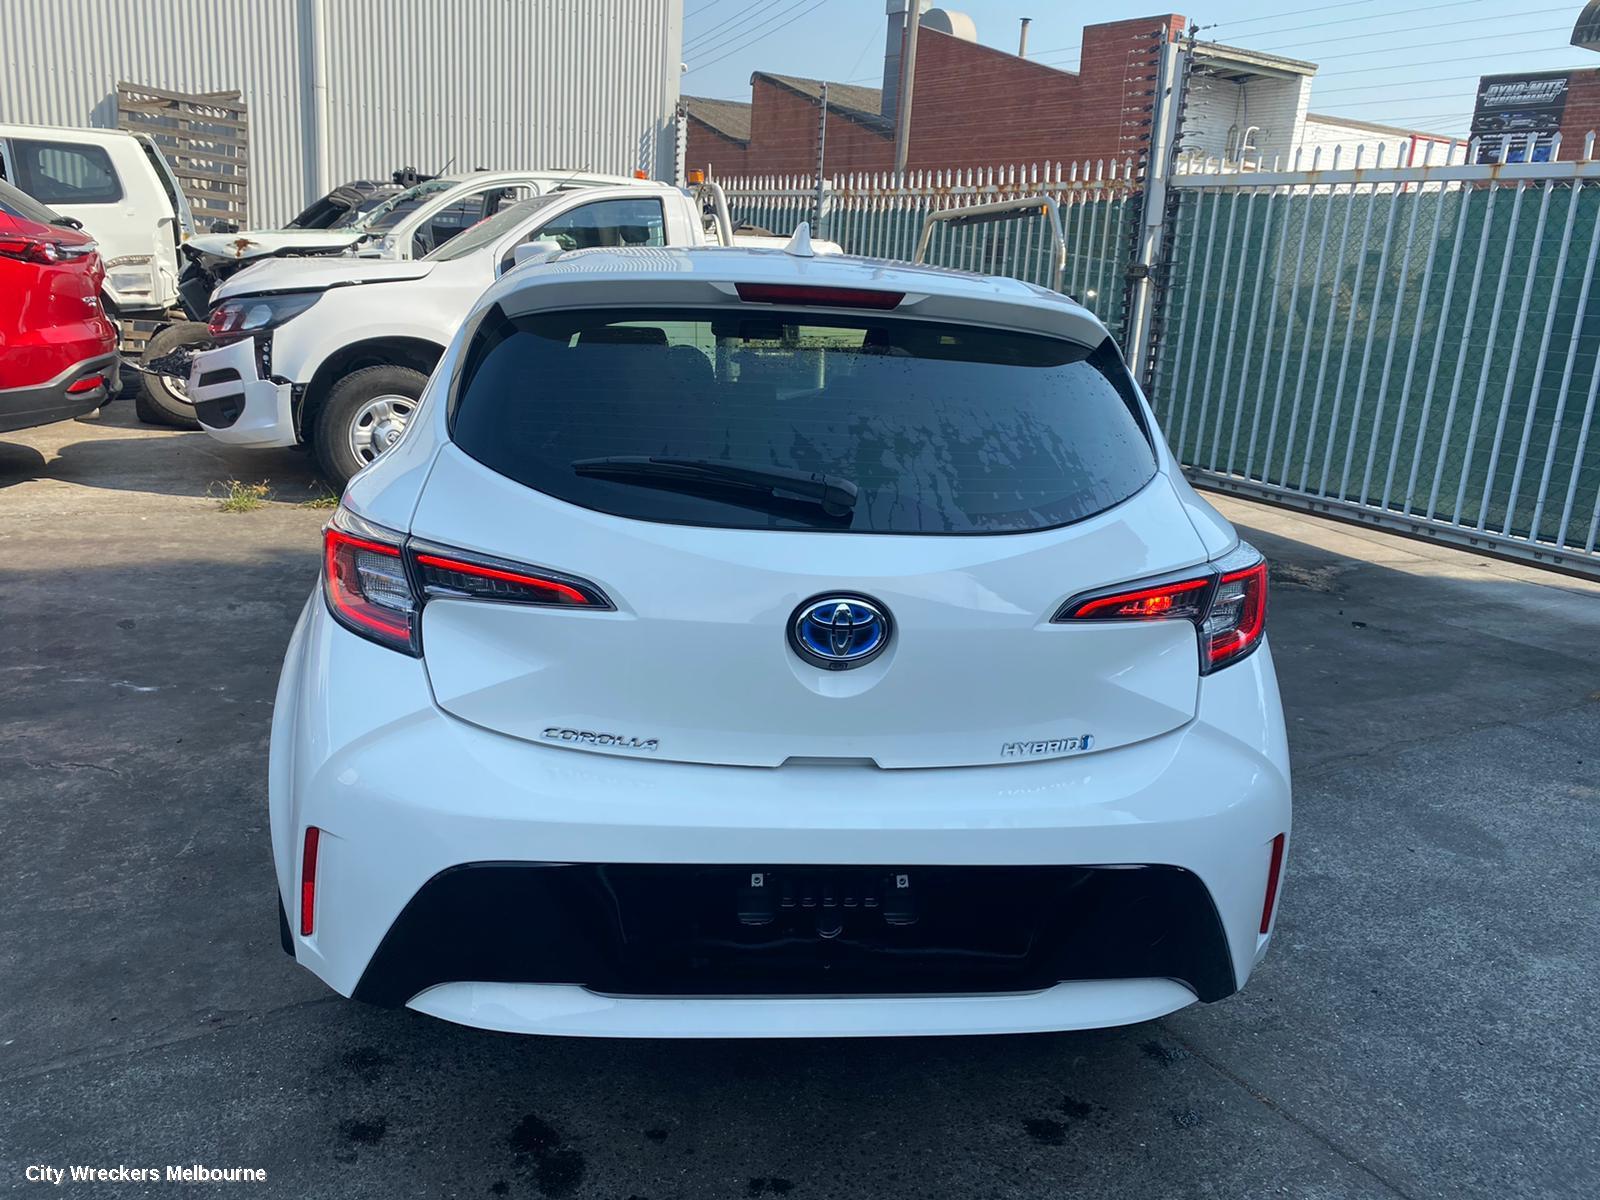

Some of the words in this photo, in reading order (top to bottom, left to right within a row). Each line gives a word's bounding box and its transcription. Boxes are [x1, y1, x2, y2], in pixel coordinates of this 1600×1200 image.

[1485, 92, 1556, 105] PERFORMANCE
[541, 727, 659, 751] COROLLA
[1000, 737, 1081, 757] HYBRID
